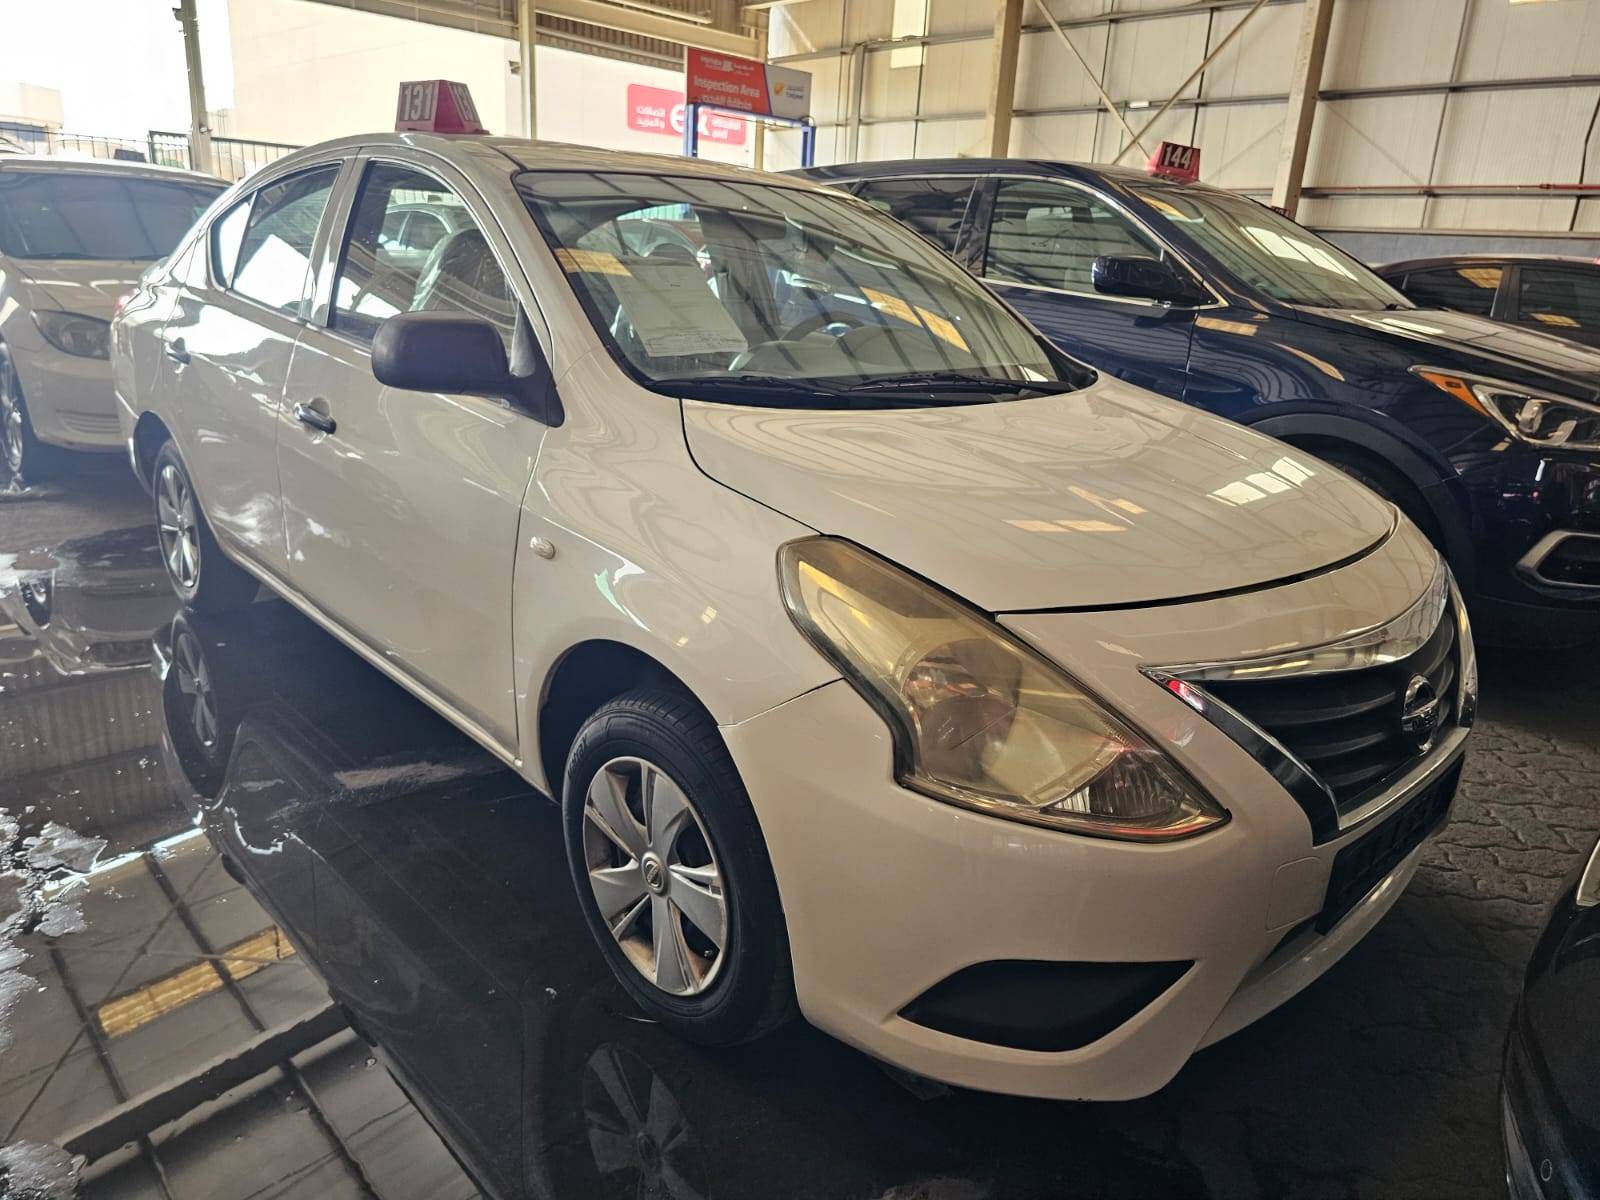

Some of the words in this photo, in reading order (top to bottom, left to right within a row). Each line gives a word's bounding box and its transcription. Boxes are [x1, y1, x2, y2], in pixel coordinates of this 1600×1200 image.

[694, 75, 739, 94] Inspection
[740, 84, 761, 98] Area
[404, 84, 433, 120] 131
[1163, 144, 1193, 170] 144
